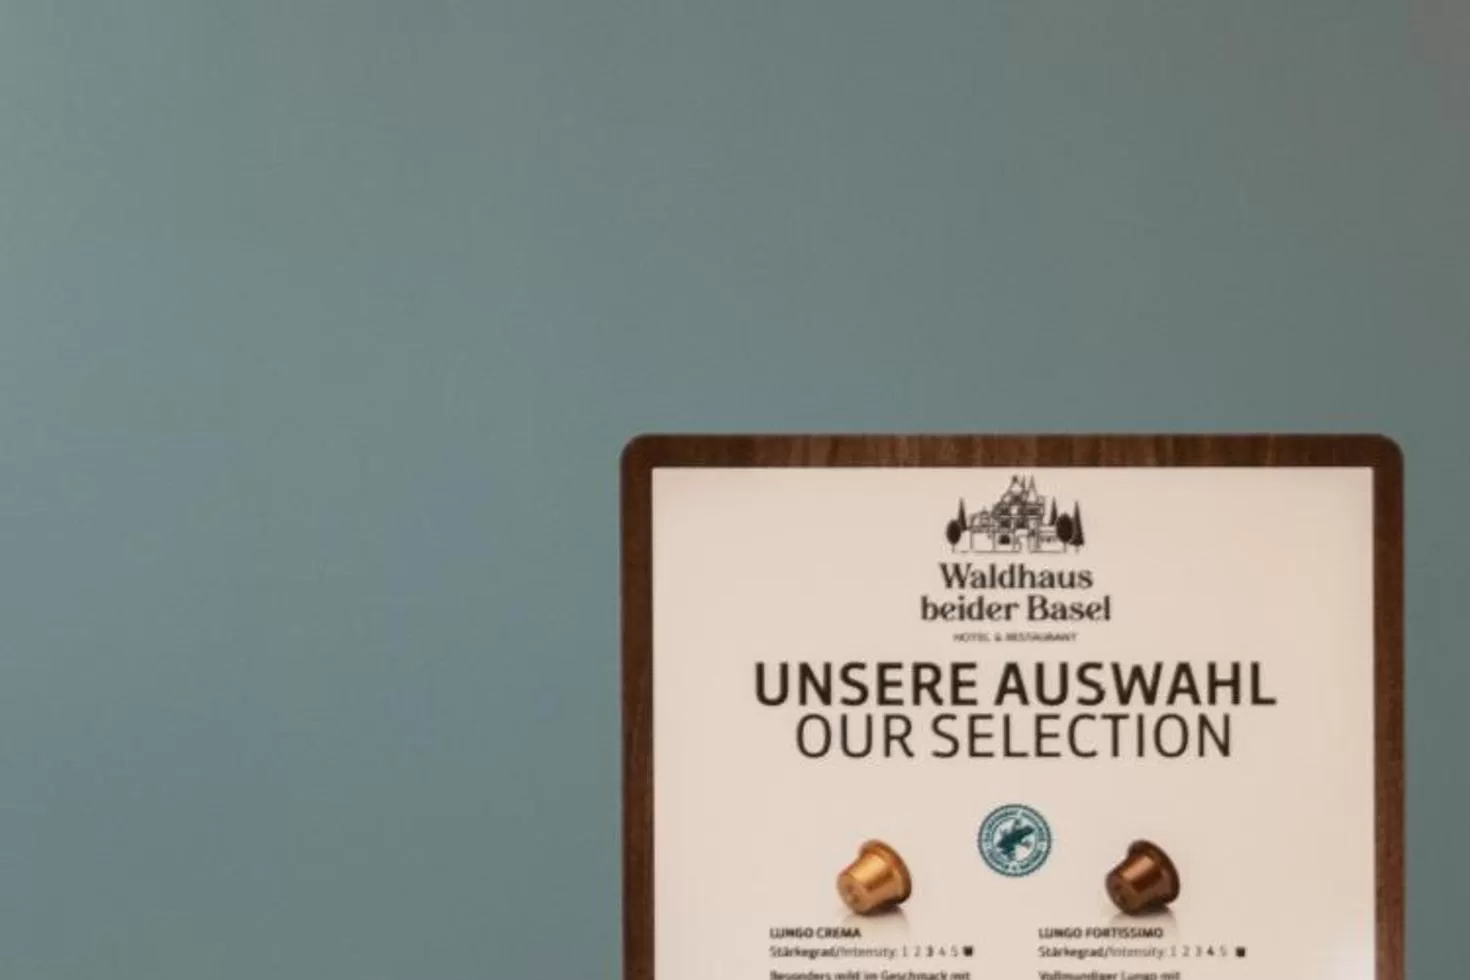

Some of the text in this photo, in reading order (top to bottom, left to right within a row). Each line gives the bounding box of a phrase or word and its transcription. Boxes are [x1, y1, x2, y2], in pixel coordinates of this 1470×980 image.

[939, 562, 1092, 590] Waldhaus
[921, 595, 1111, 621] beider Basel
[754, 661, 1276, 706] UNSERE AUSWAHL
[796, 714, 1232, 758] OUR SELECTION
[769, 927, 861, 938] LUNGO CREMA
[1038, 928, 1163, 938] LUNGO FORTISSIMO
[925, 946, 934, 956] 3
[939, 946, 946, 956] 4
[951, 946, 958, 956] 5
[1207, 946, 1214, 956] 4
[770, 971, 970, 980] Besonders mild im Geschmack mit
[1160, 971, 1180, 980] mit
